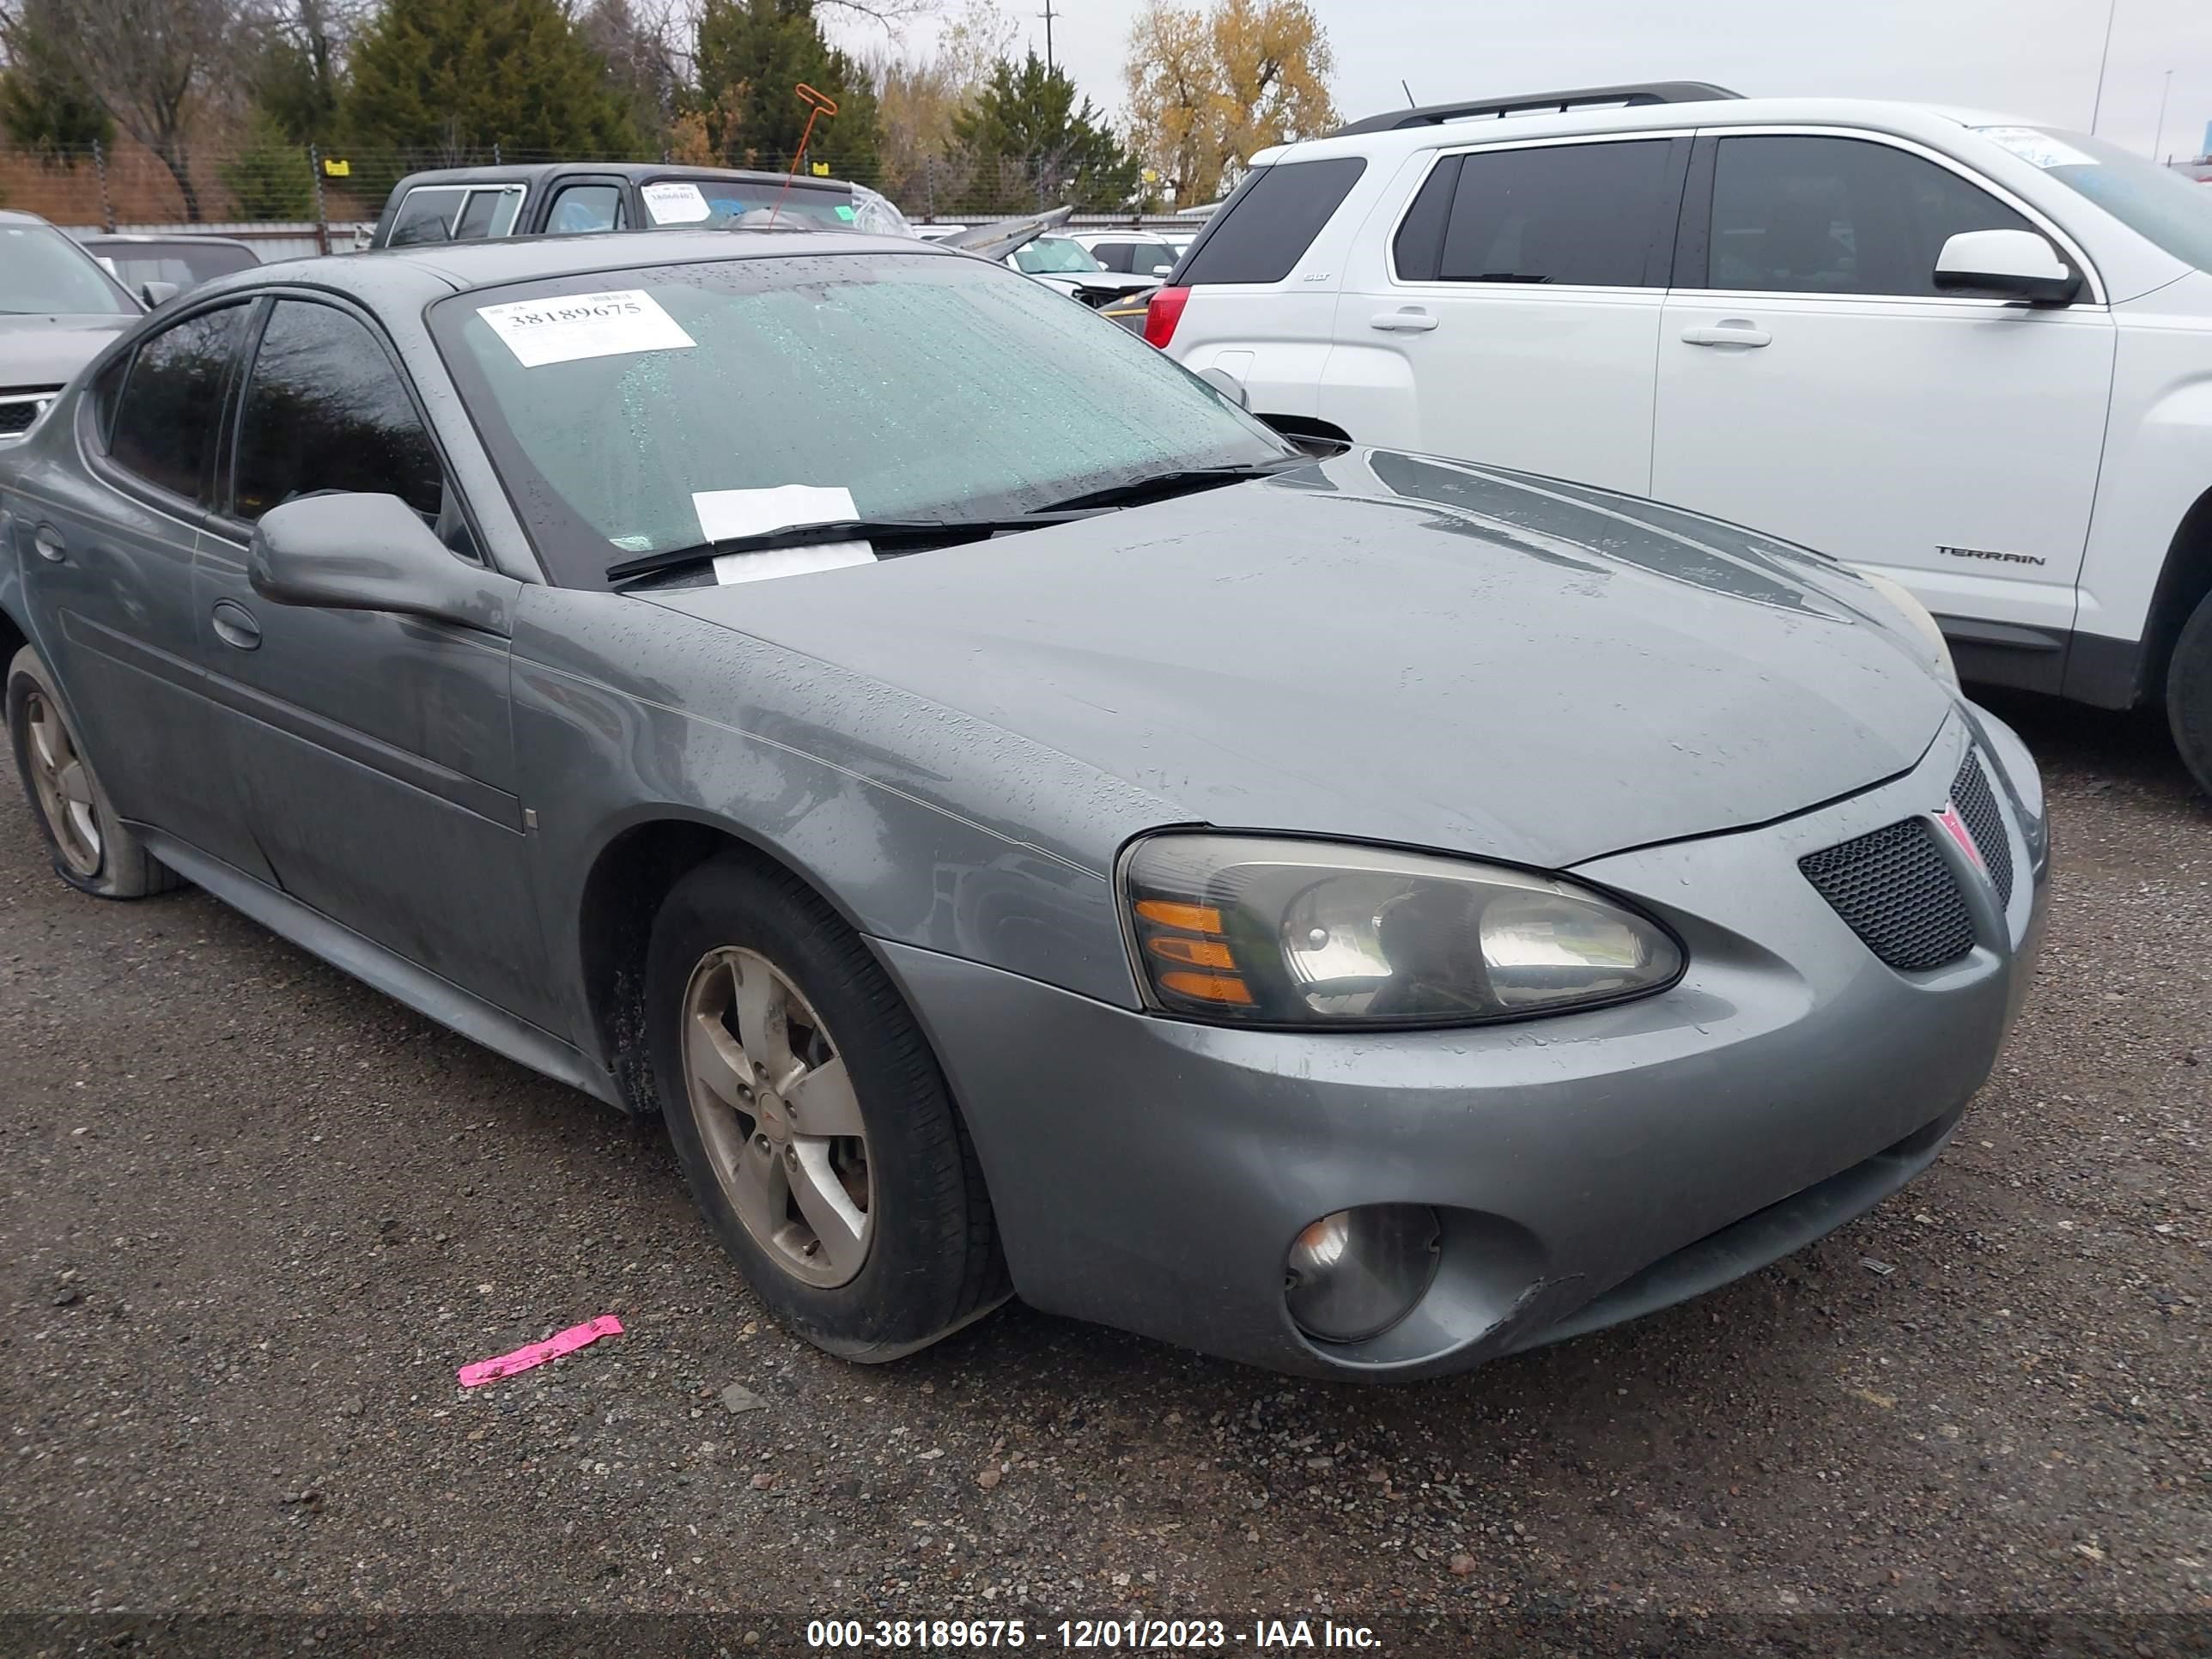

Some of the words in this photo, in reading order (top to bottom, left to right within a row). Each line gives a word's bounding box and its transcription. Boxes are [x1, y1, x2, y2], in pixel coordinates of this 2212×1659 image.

[1304, 273, 1331, 282] SLT
[507, 302, 641, 328] 38189675
[1934, 544, 2047, 566] TERRAIN
